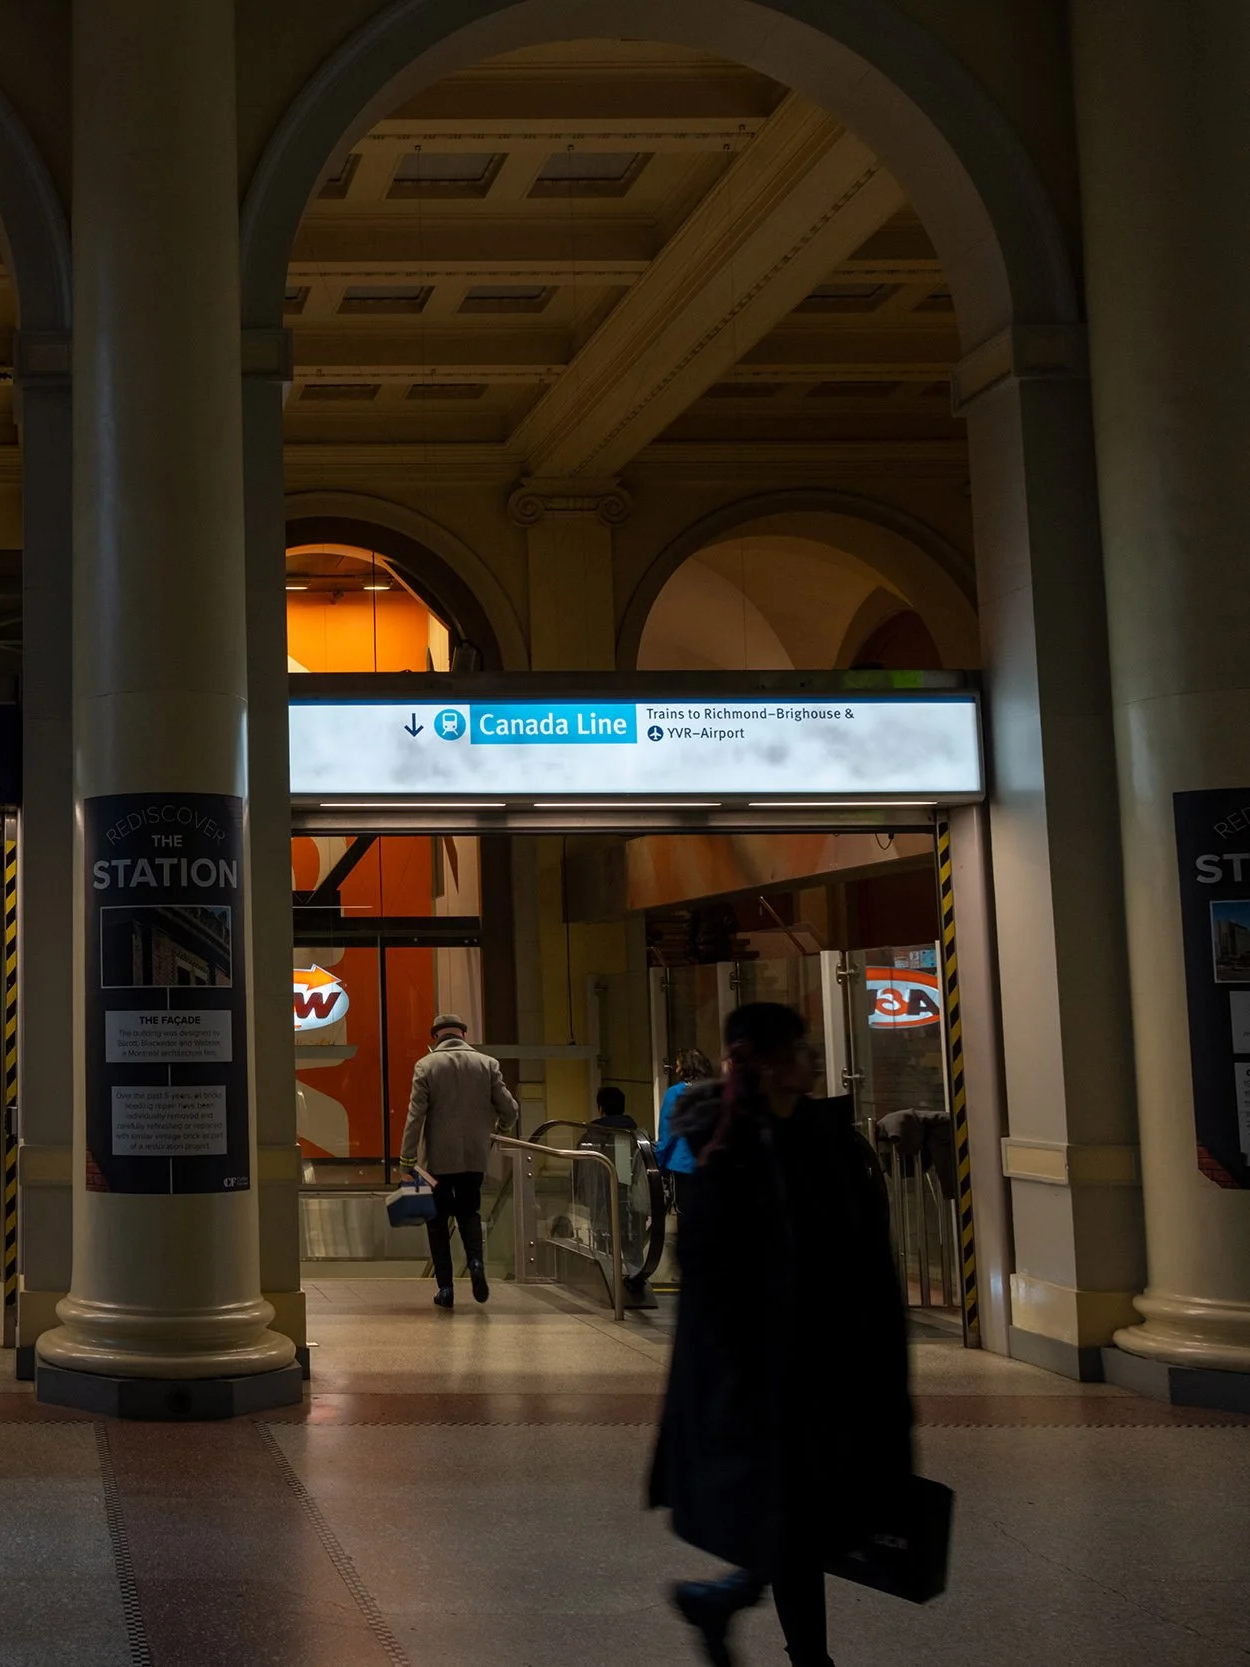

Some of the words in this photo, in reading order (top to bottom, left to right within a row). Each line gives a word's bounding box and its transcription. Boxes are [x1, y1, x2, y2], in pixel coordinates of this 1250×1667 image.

[646, 708, 684, 720] Trains
[688, 709, 701, 720] to
[845, 708, 855, 719] &
[479, 712, 569, 735] Canada
[577, 712, 627, 735] Line
[105, 804, 226, 846] REDISCOVER
[151, 835, 183, 847] THE
[93, 857, 238, 890] STATION
[139, 1016, 159, 1025] THE
[161, 1016, 201, 1027] FAÇADE
